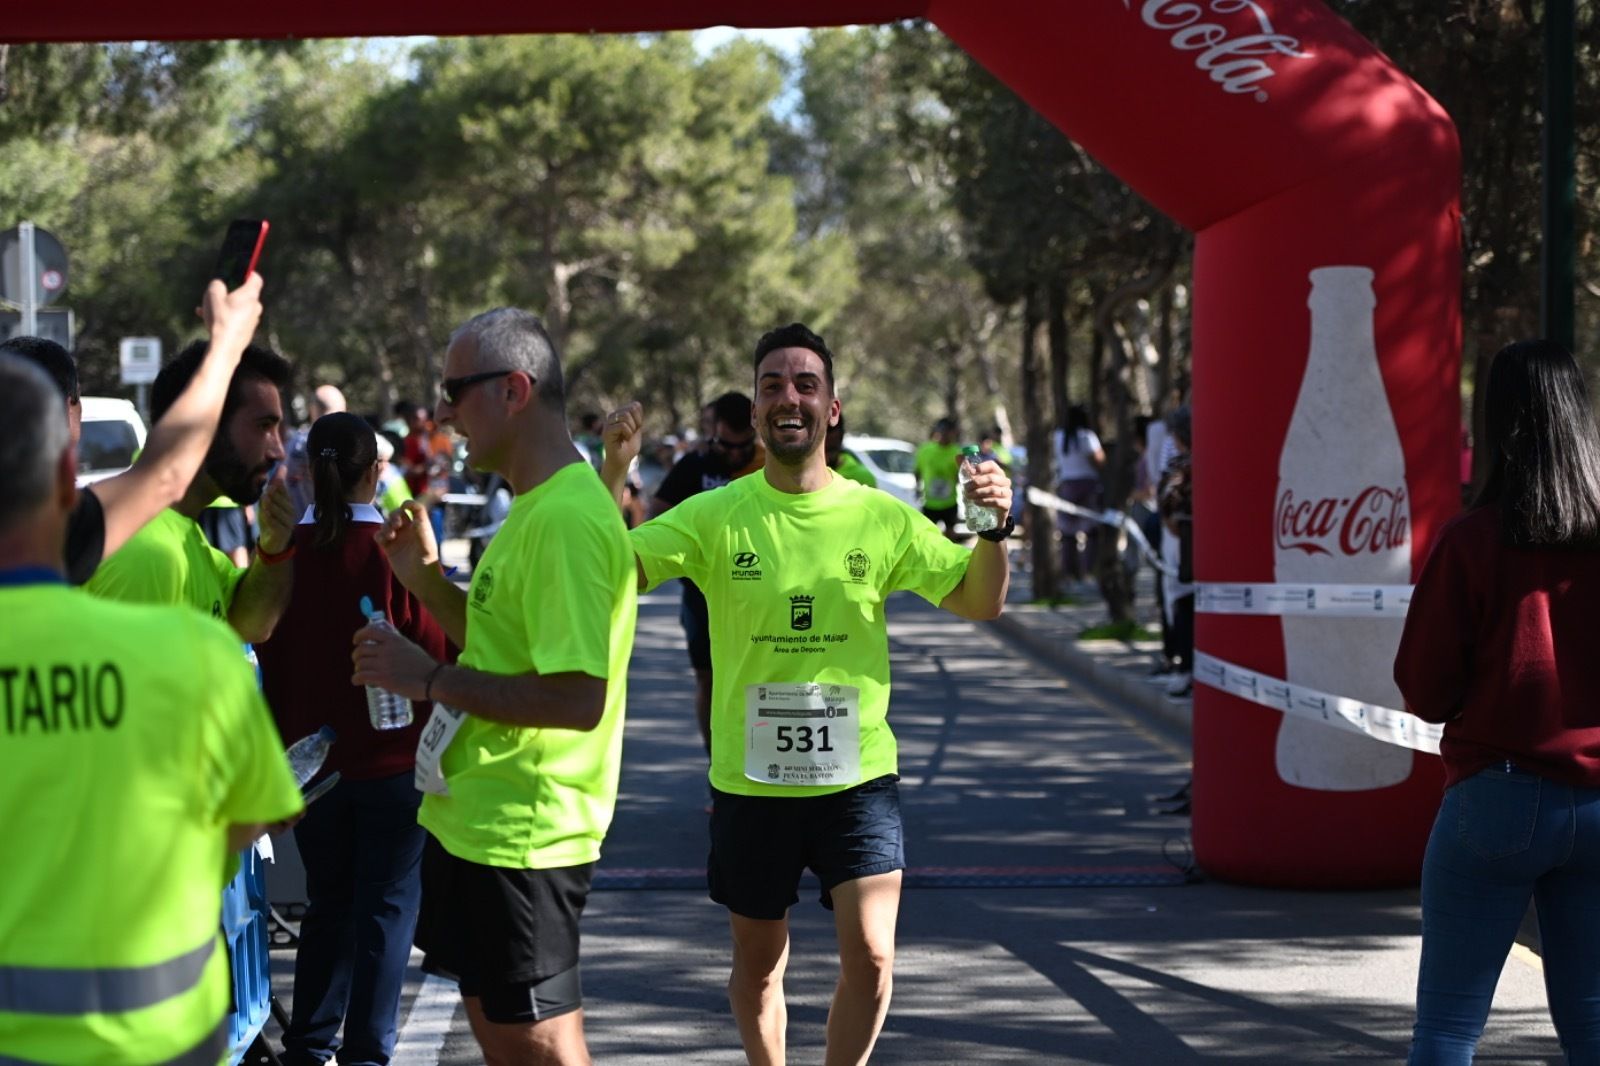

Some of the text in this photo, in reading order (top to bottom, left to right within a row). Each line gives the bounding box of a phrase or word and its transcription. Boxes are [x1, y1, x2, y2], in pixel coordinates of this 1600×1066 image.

[1276, 485, 1408, 556] Coca-Cola
[810, 634, 821, 643] de
[0, 661, 126, 734] TARIO
[776, 725, 834, 752] 531
